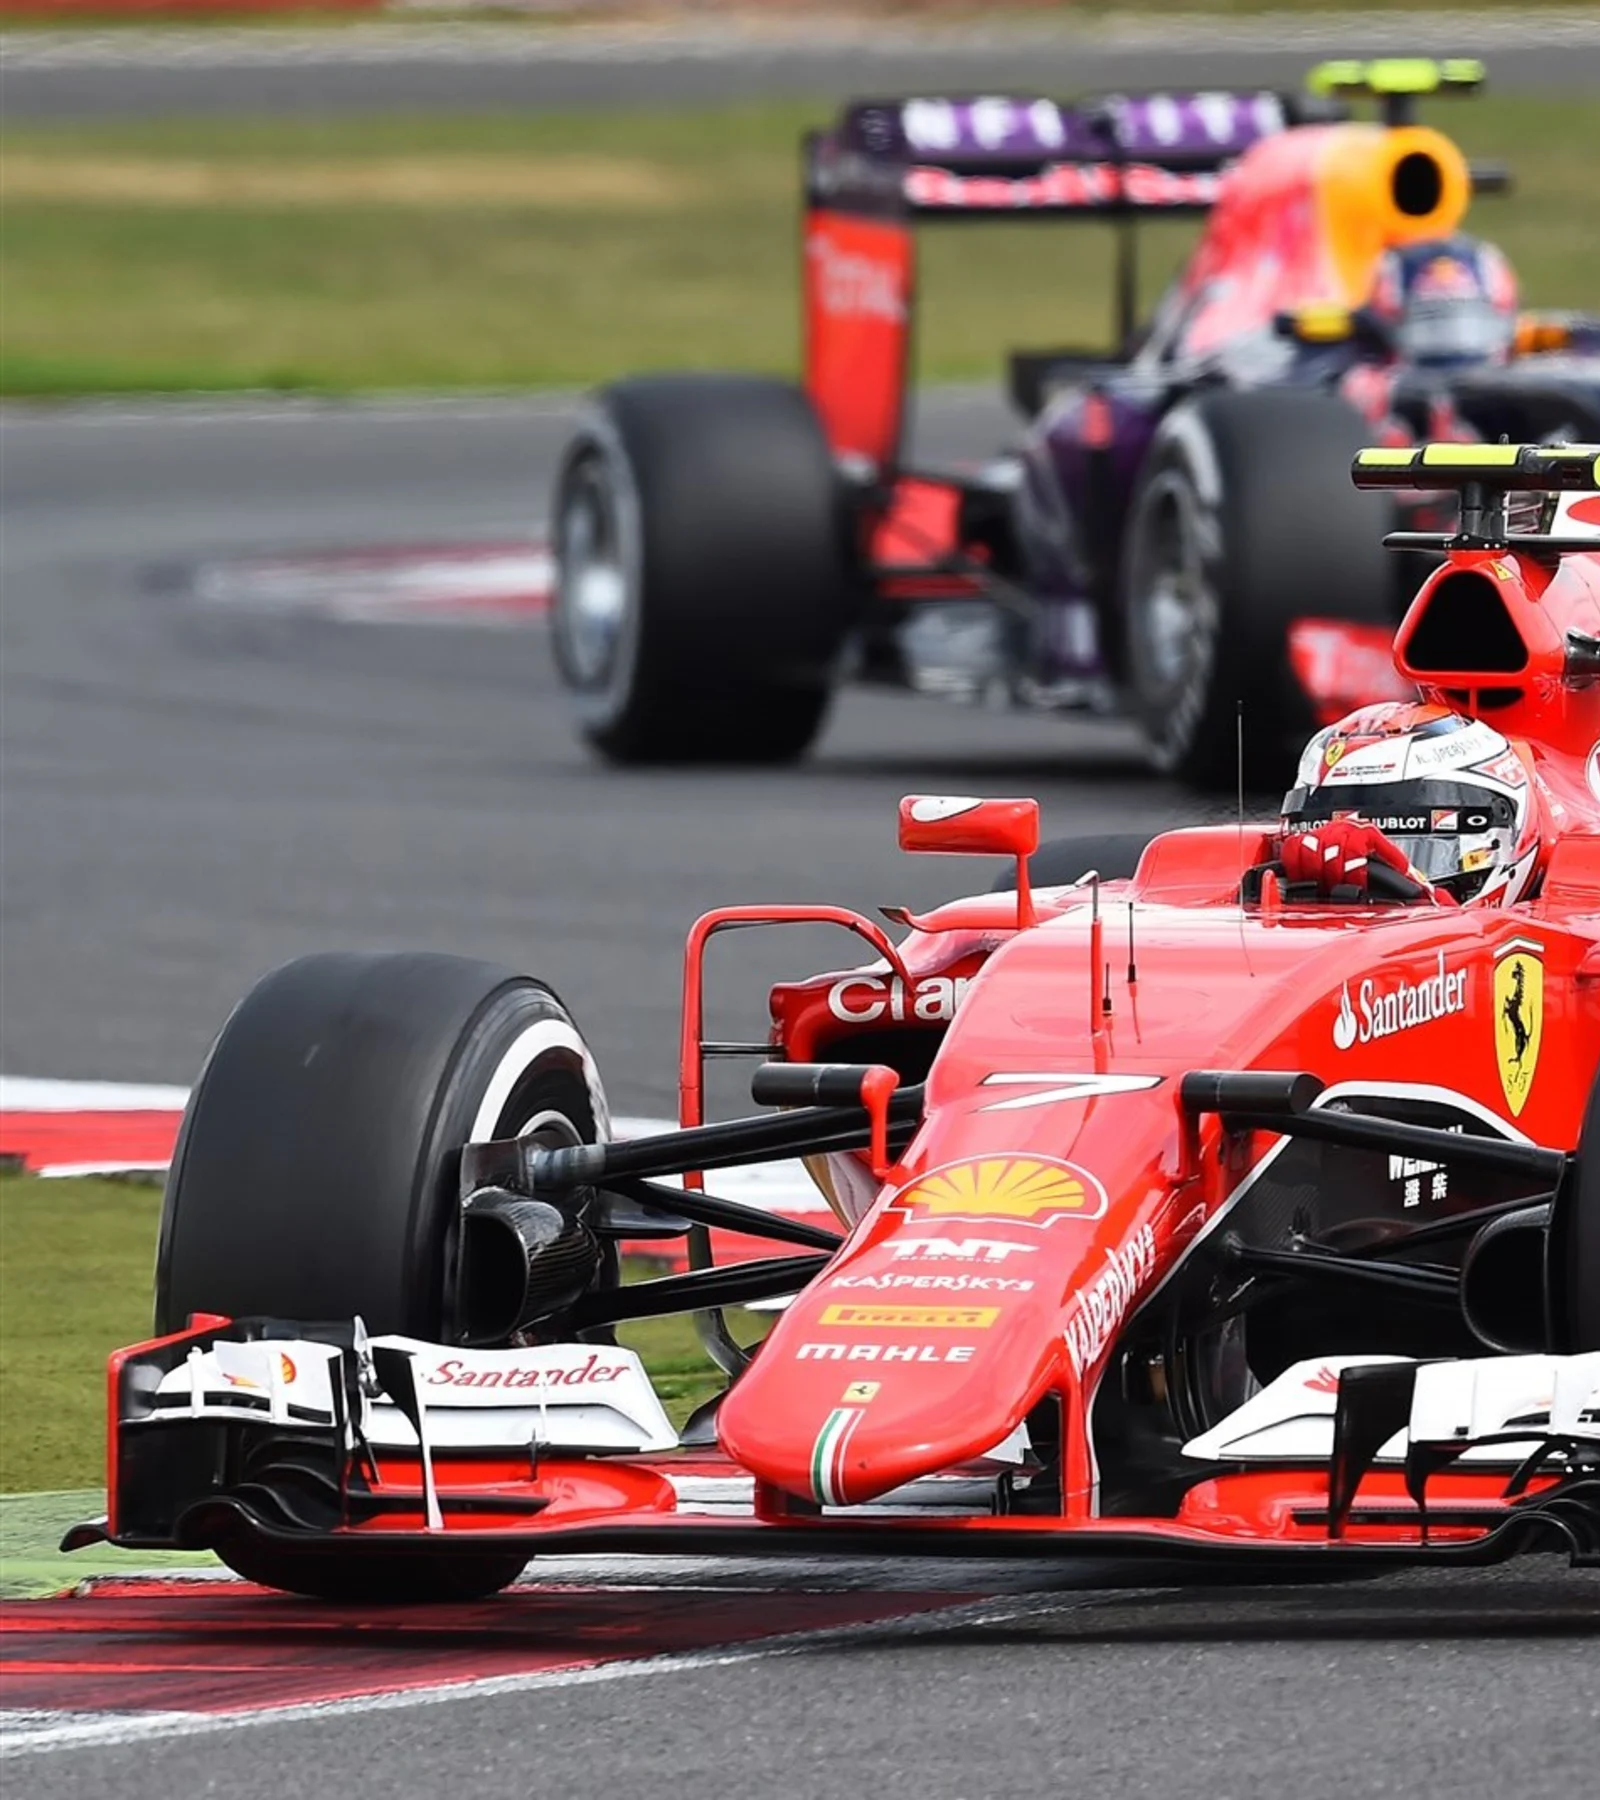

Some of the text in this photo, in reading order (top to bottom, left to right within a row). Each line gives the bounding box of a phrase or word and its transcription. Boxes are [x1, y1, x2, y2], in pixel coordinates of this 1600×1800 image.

[1358, 948, 1467, 1043] Santander
[972, 1072, 1166, 1113] 7
[880, 1238, 1040, 1259] TNT
[830, 1272, 1034, 1291] KASPERSKY
[795, 1343, 976, 1362] MAHLE
[428, 1354, 630, 1388] Santander
